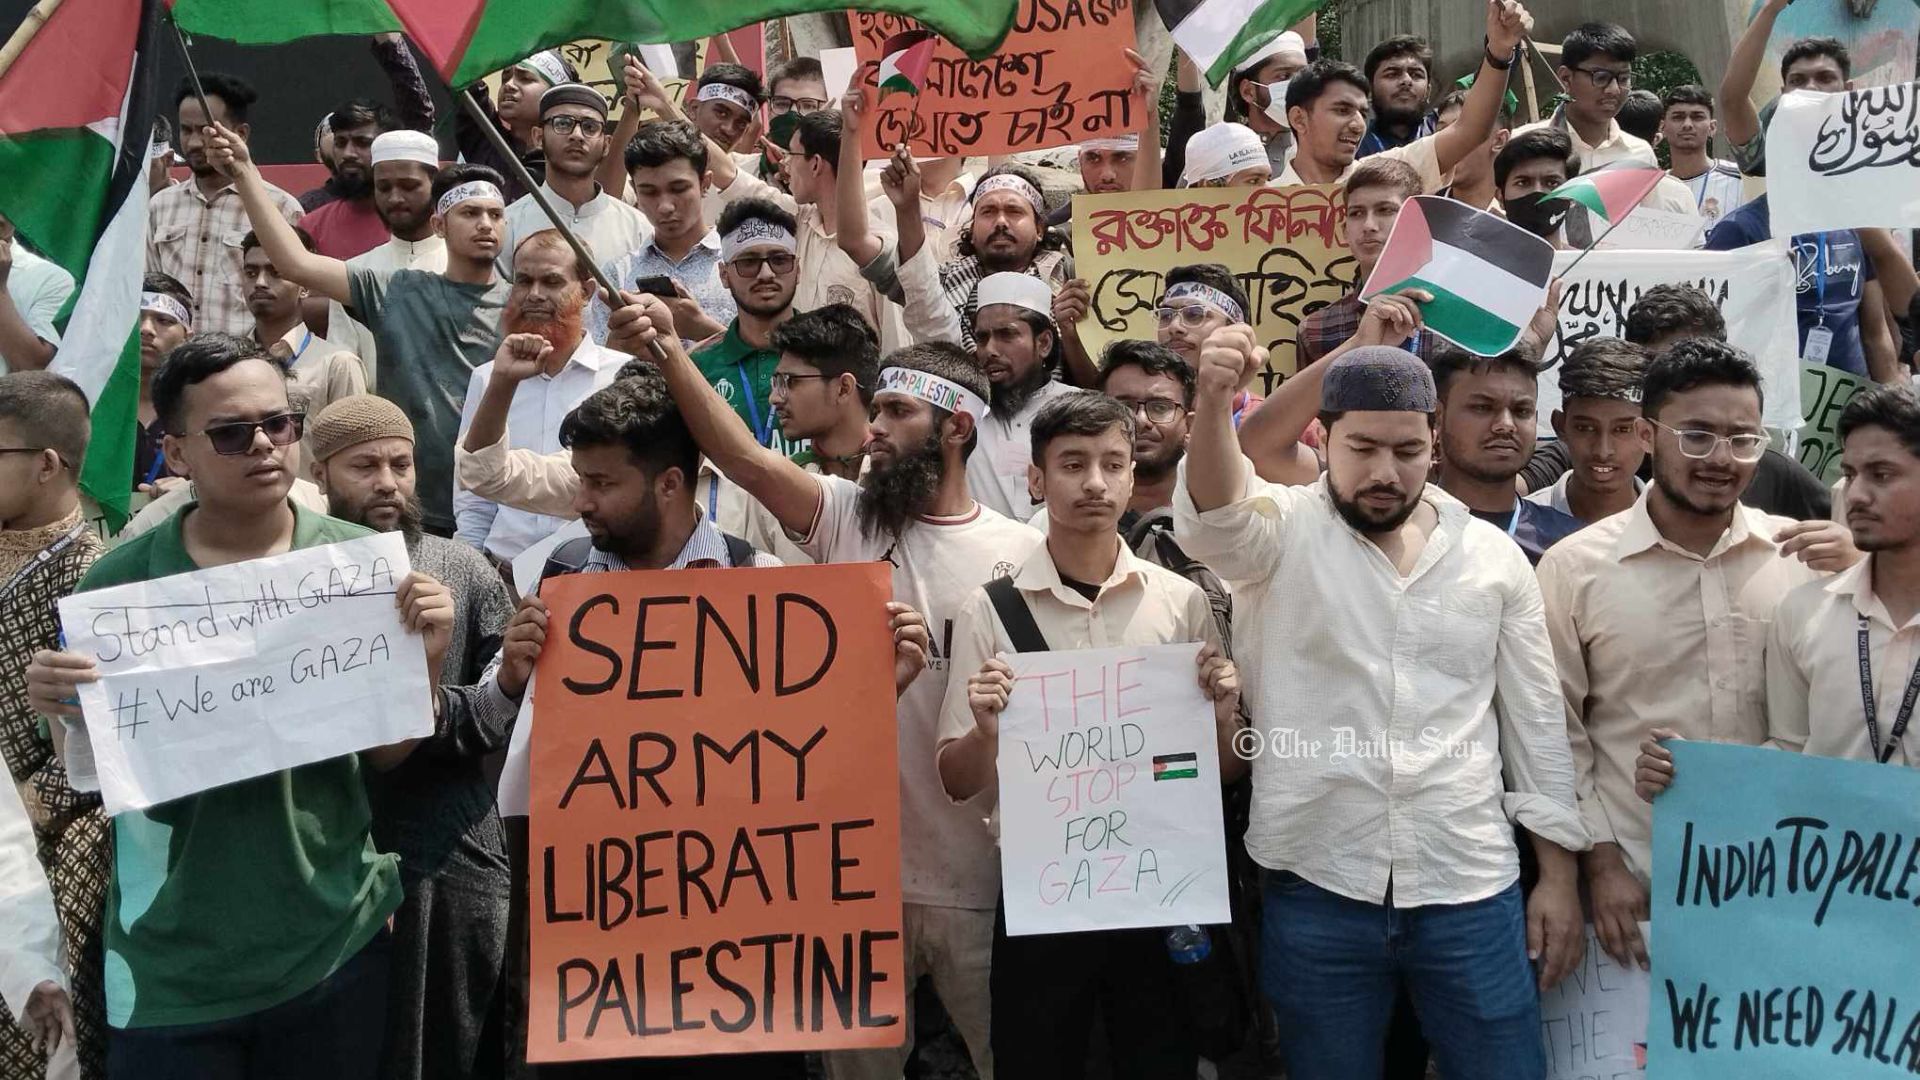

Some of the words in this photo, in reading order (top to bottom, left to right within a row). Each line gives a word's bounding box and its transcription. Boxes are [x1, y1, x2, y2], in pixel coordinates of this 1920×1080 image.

[906, 373, 964, 412] PALESTINE
[91, 585, 219, 663] Stand
[227, 581, 295, 631] with
[297, 556, 394, 609] GAZA
[561, 592, 838, 700] SEND
[231, 674, 274, 702] are
[290, 632, 391, 685] GAZA
[1014, 657, 1151, 732] THE
[558, 725, 828, 810] ARMY
[1025, 722, 1145, 773] WORLD
[1046, 763, 1137, 818] STOP
[1065, 810, 1133, 854] FOR
[543, 818, 876, 931] LIBERATE
[1038, 848, 1161, 905] GAZA
[1676, 822, 1776, 907] INDIA
[1776, 817, 1829, 894] TO
[1814, 830, 1920, 927] PALE
[557, 930, 900, 1043] PALESTINE
[1665, 979, 1722, 1053] WE
[1734, 986, 1824, 1051] NEED
[1541, 1010, 1617, 1073] THE
